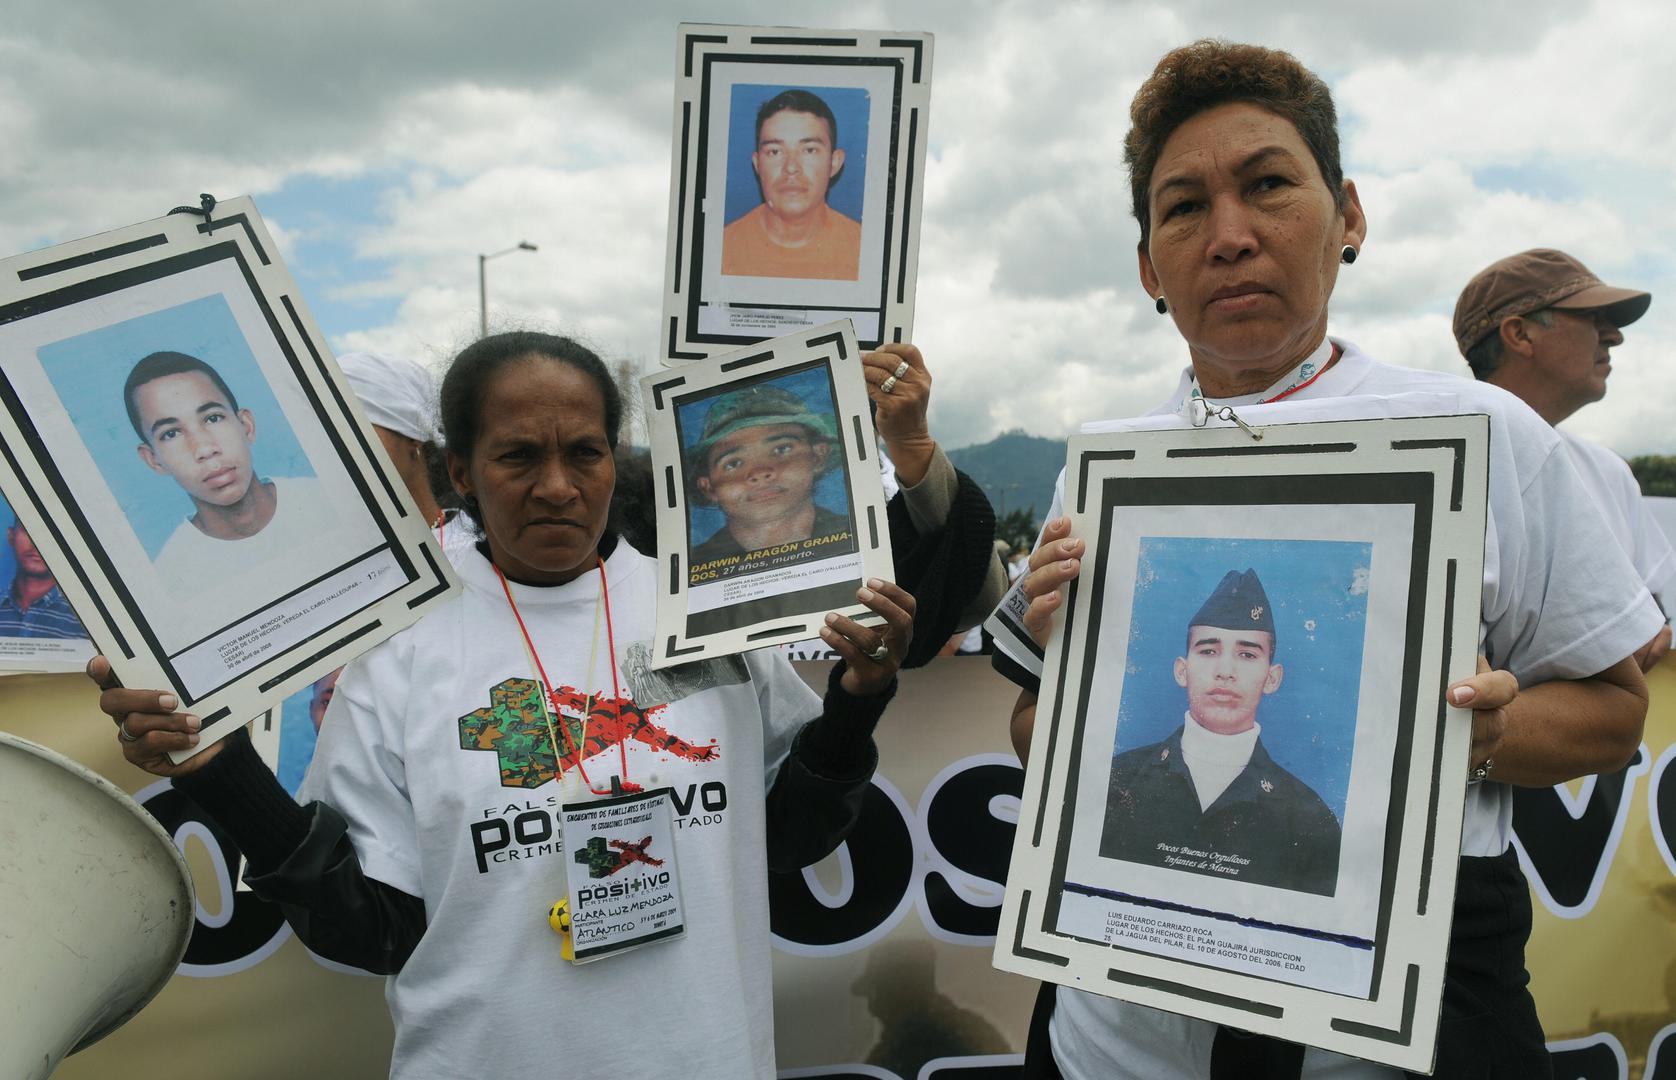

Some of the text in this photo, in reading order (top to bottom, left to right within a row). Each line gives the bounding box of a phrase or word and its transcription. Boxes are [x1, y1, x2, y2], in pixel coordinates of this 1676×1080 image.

[690, 550, 815, 583] DOS, 27 años, muerto.
[691, 532, 853, 573] DARWIN ARAGÓN GRANA-
[216, 613, 285, 652] VICTOR MANUEL MENDOZA
[220, 644, 240, 658] LUGAR
[239, 640, 248, 648] DE
[247, 634, 259, 644] LOS
[1156, 842, 1180, 852] Pocos
[1180, 846, 1208, 858] Buenos
[1164, 855, 1240, 875] Infantes de Marina
[573, 892, 674, 922] CLARA LUZ MENDOZA
[584, 897, 620, 906] CRIMEN
[641, 884, 669, 895] ESTADO
[577, 921, 636, 939] ATLANTICO
[1107, 911, 1213, 937] LUIS EDUARDO CARRIAZO ROCA
[1105, 926, 1114, 934] DE
[1115, 928, 1124, 936] LA
[1125, 930, 1148, 941] JAGUA
[1148, 935, 1162, 943] DEL
[1186, 942, 1195, 950] EL
[1196, 944, 1204, 952] 10
[1205, 946, 1216, 954] DE
[1216, 948, 1247, 960] AGOSTO
[1248, 954, 1263, 964] DEL
[1284, 962, 1305, 972] EDAD
[1106, 918, 1129, 928] LUGAR
[1140, 925, 1154, 933] LOS
[1155, 927, 1186, 940] HECHOS:
[1186, 934, 1195, 942] EL
[1196, 936, 1216, 946] PLAN
[1216, 939, 1248, 952] GUAJIRA
[1248, 945, 1301, 963] JURISDICCION
